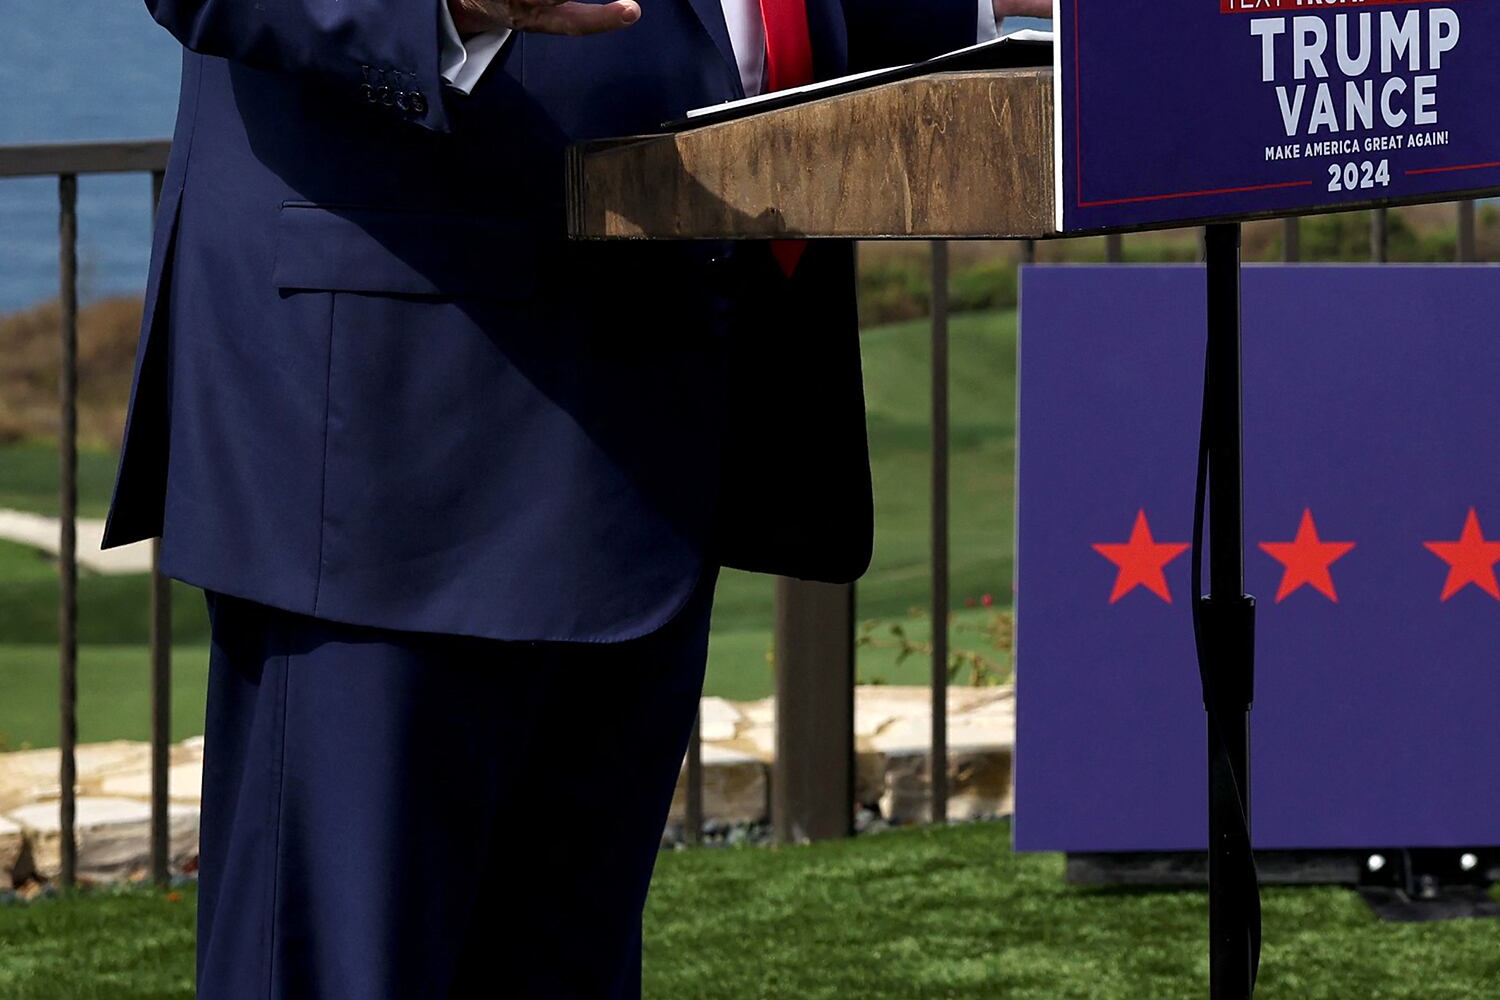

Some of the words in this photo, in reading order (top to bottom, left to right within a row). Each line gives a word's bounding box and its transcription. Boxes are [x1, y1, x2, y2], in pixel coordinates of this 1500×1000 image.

[1250, 7, 1460, 82] TRUMP
[1276, 74, 1438, 137] VANCE
[1265, 144, 1301, 161] MAKE
[1304, 139, 1360, 157] AMERICA
[1364, 135, 1403, 151] GREAT
[1407, 131, 1449, 148] AGAIN!
[1327, 159, 1391, 192] 2024
